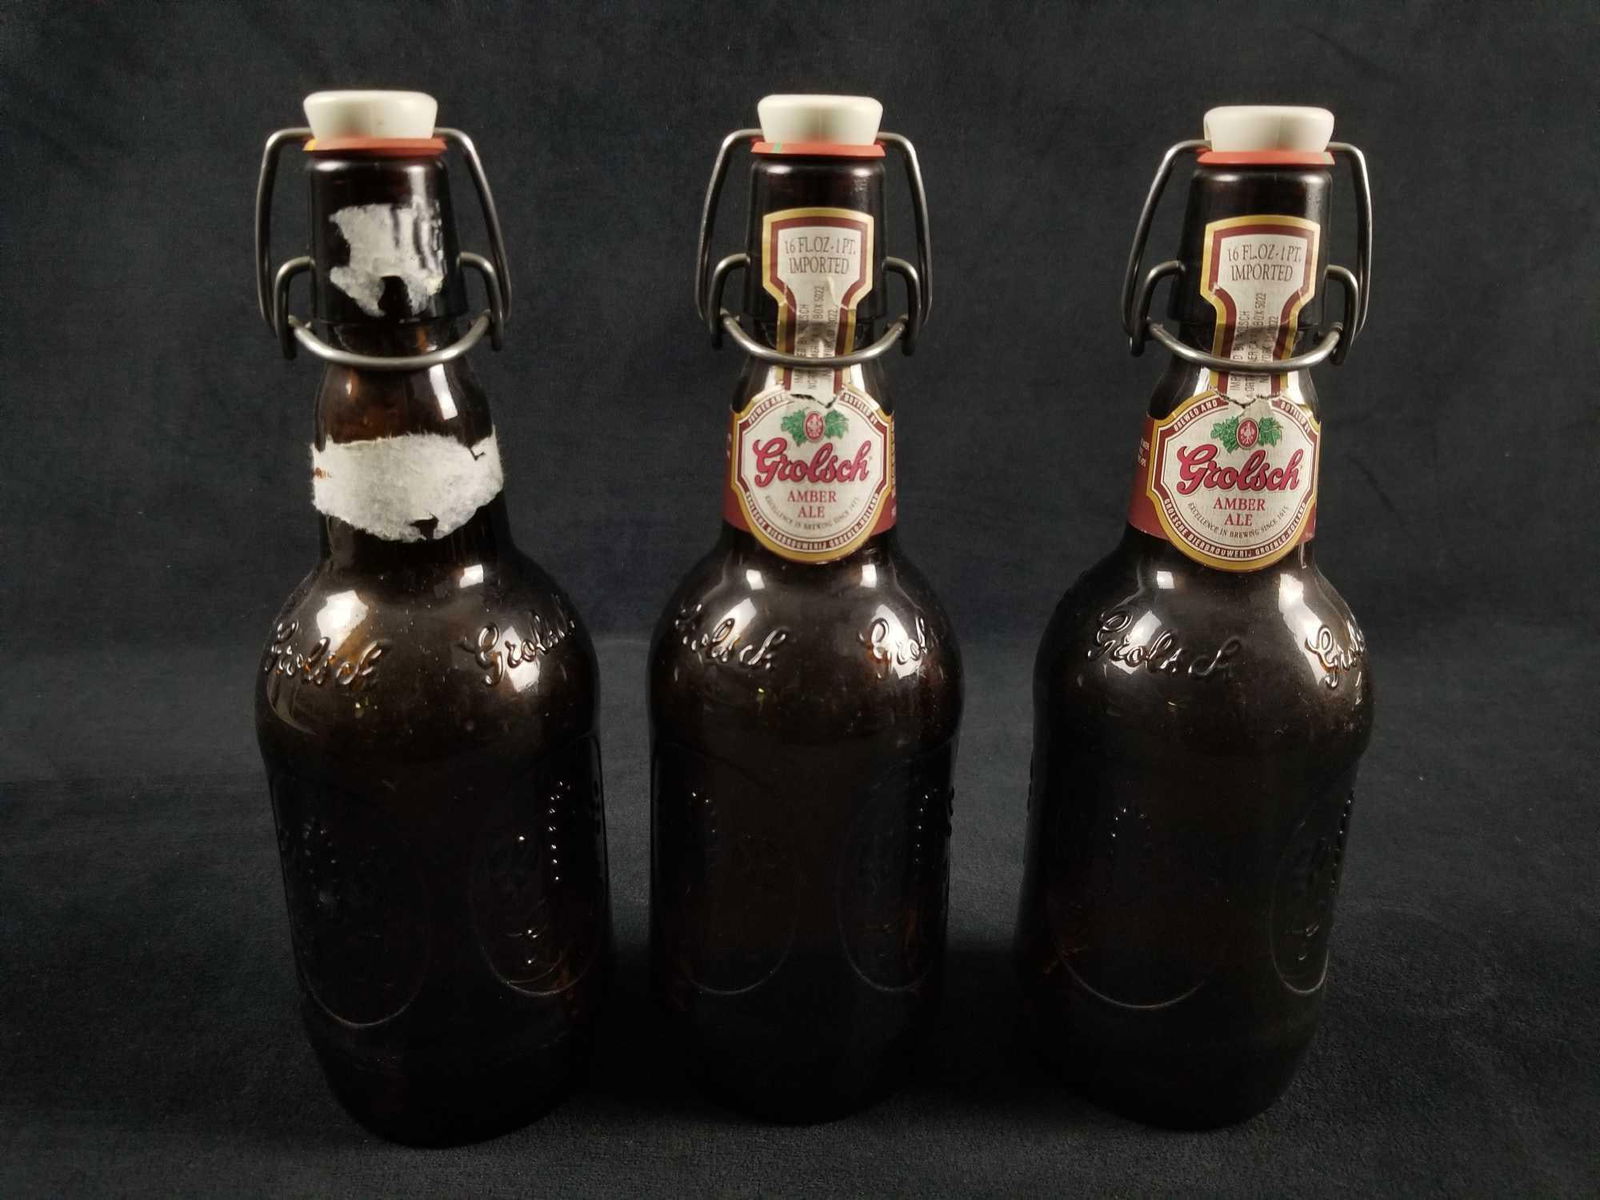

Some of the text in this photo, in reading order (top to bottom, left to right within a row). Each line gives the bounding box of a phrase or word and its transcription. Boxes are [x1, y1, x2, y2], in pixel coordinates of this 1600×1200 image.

[785, 239, 796, 254] 16
[1228, 247, 1239, 262] 16
[789, 257, 849, 274] IMPORTED
[1231, 263, 1293, 281] IMPORTED
[1200, 400, 1218, 412] AND
[752, 437, 872, 487] Grolsch
[1176, 443, 1304, 495] Grolsch
[787, 491, 837, 503] AMBER
[1213, 497, 1266, 512] AMBER
[798, 506, 825, 518] ALE
[1224, 512, 1253, 527] ALE
[1220, 527, 1228, 537] IN
[1229, 529, 1260, 539] BREWING
